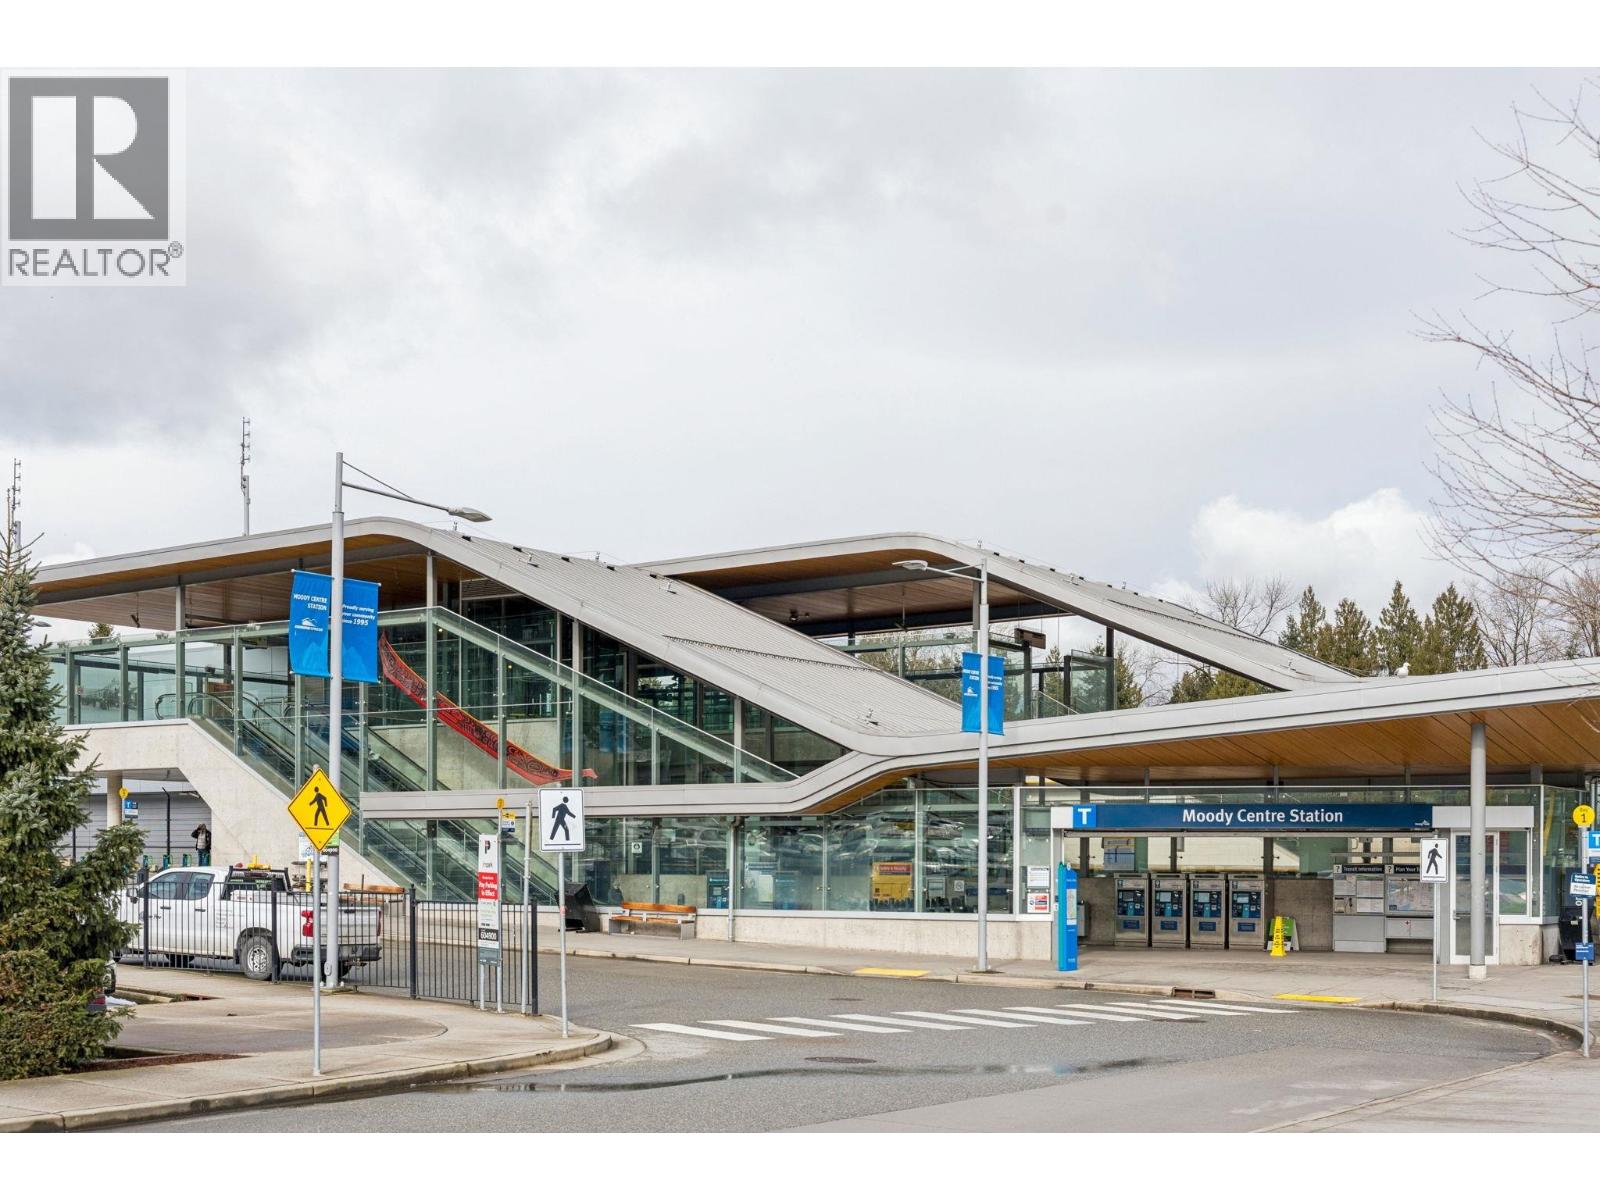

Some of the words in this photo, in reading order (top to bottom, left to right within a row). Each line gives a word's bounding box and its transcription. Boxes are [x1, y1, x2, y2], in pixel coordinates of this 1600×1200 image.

[293, 593, 310, 601] MOODY
[310, 595, 328, 604] CENTRE
[307, 602, 327, 611] STATION
[1078, 808, 1092, 824] T
[1182, 808, 1234, 826] Moody
[1236, 809, 1286, 822] Centre
[1289, 808, 1344, 822] Station
[1580, 813, 1586, 822] 1
